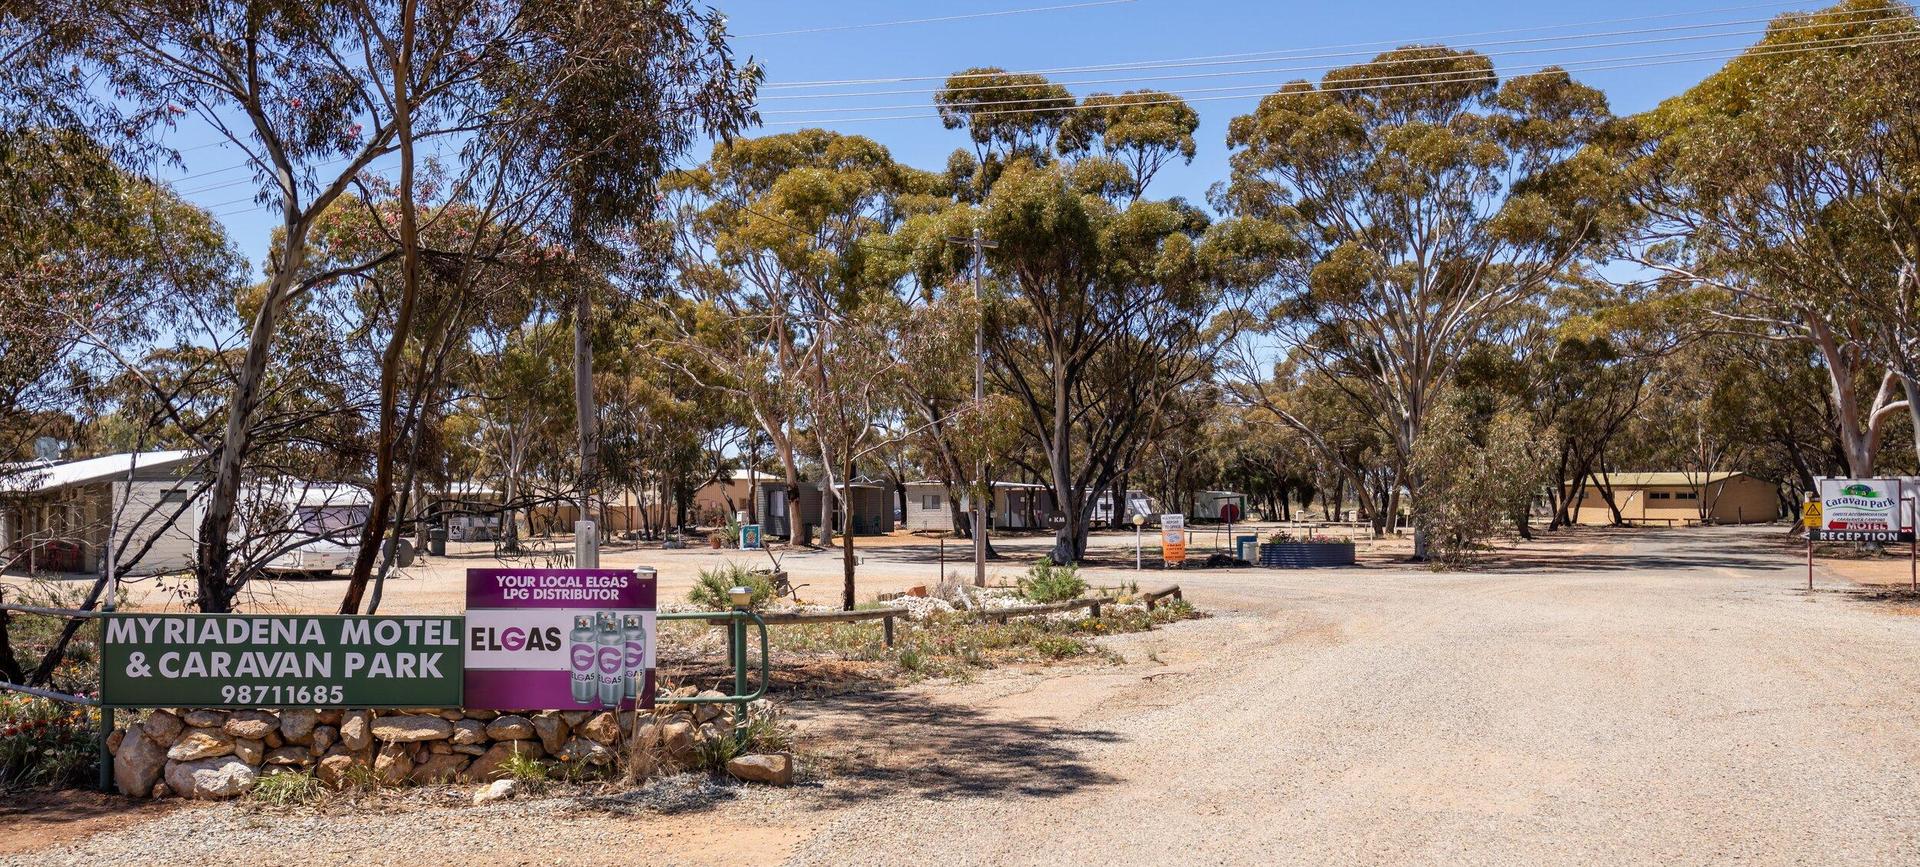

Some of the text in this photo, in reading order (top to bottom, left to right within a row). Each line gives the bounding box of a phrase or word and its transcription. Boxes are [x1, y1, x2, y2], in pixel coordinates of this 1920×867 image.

[1825, 497, 1895, 509] Caravan Park
[1846, 521, 1887, 530] MOTEL
[1820, 532, 1898, 541] RECEPTION
[496, 575, 628, 588] YOUR LOCAL ELGAS
[503, 588, 620, 600] LPG DISTRIBUTOR
[105, 617, 460, 646] MYRIADENA MOTEL
[471, 626, 562, 652] ELGAS
[125, 651, 444, 679] & CARAVAN PARK
[221, 685, 344, 704] 98711685
